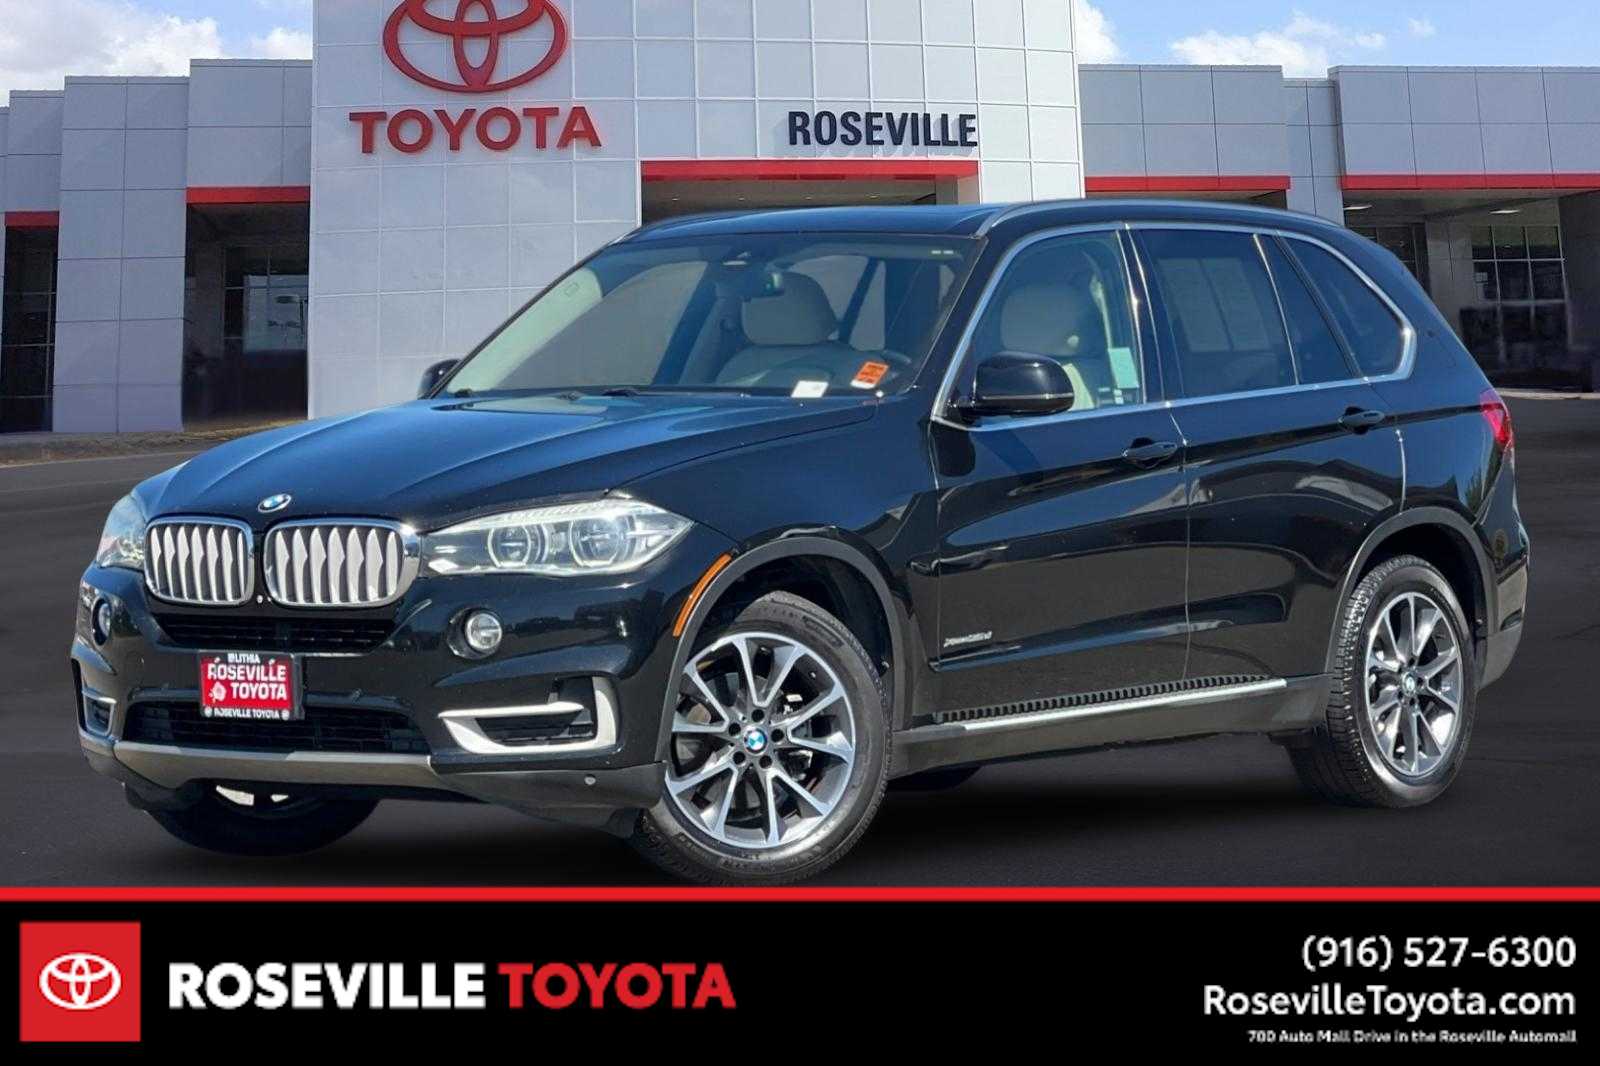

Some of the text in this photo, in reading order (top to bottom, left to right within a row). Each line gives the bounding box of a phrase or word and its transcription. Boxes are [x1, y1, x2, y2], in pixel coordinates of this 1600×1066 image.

[349, 106, 602, 154] TOYOTA
[788, 111, 978, 147] ROSEVILLE
[208, 663, 286, 681] ROSEVILLE
[230, 682, 287, 700] TOYOTA
[214, 707, 280, 719] ROSEVILLE TOYOTA
